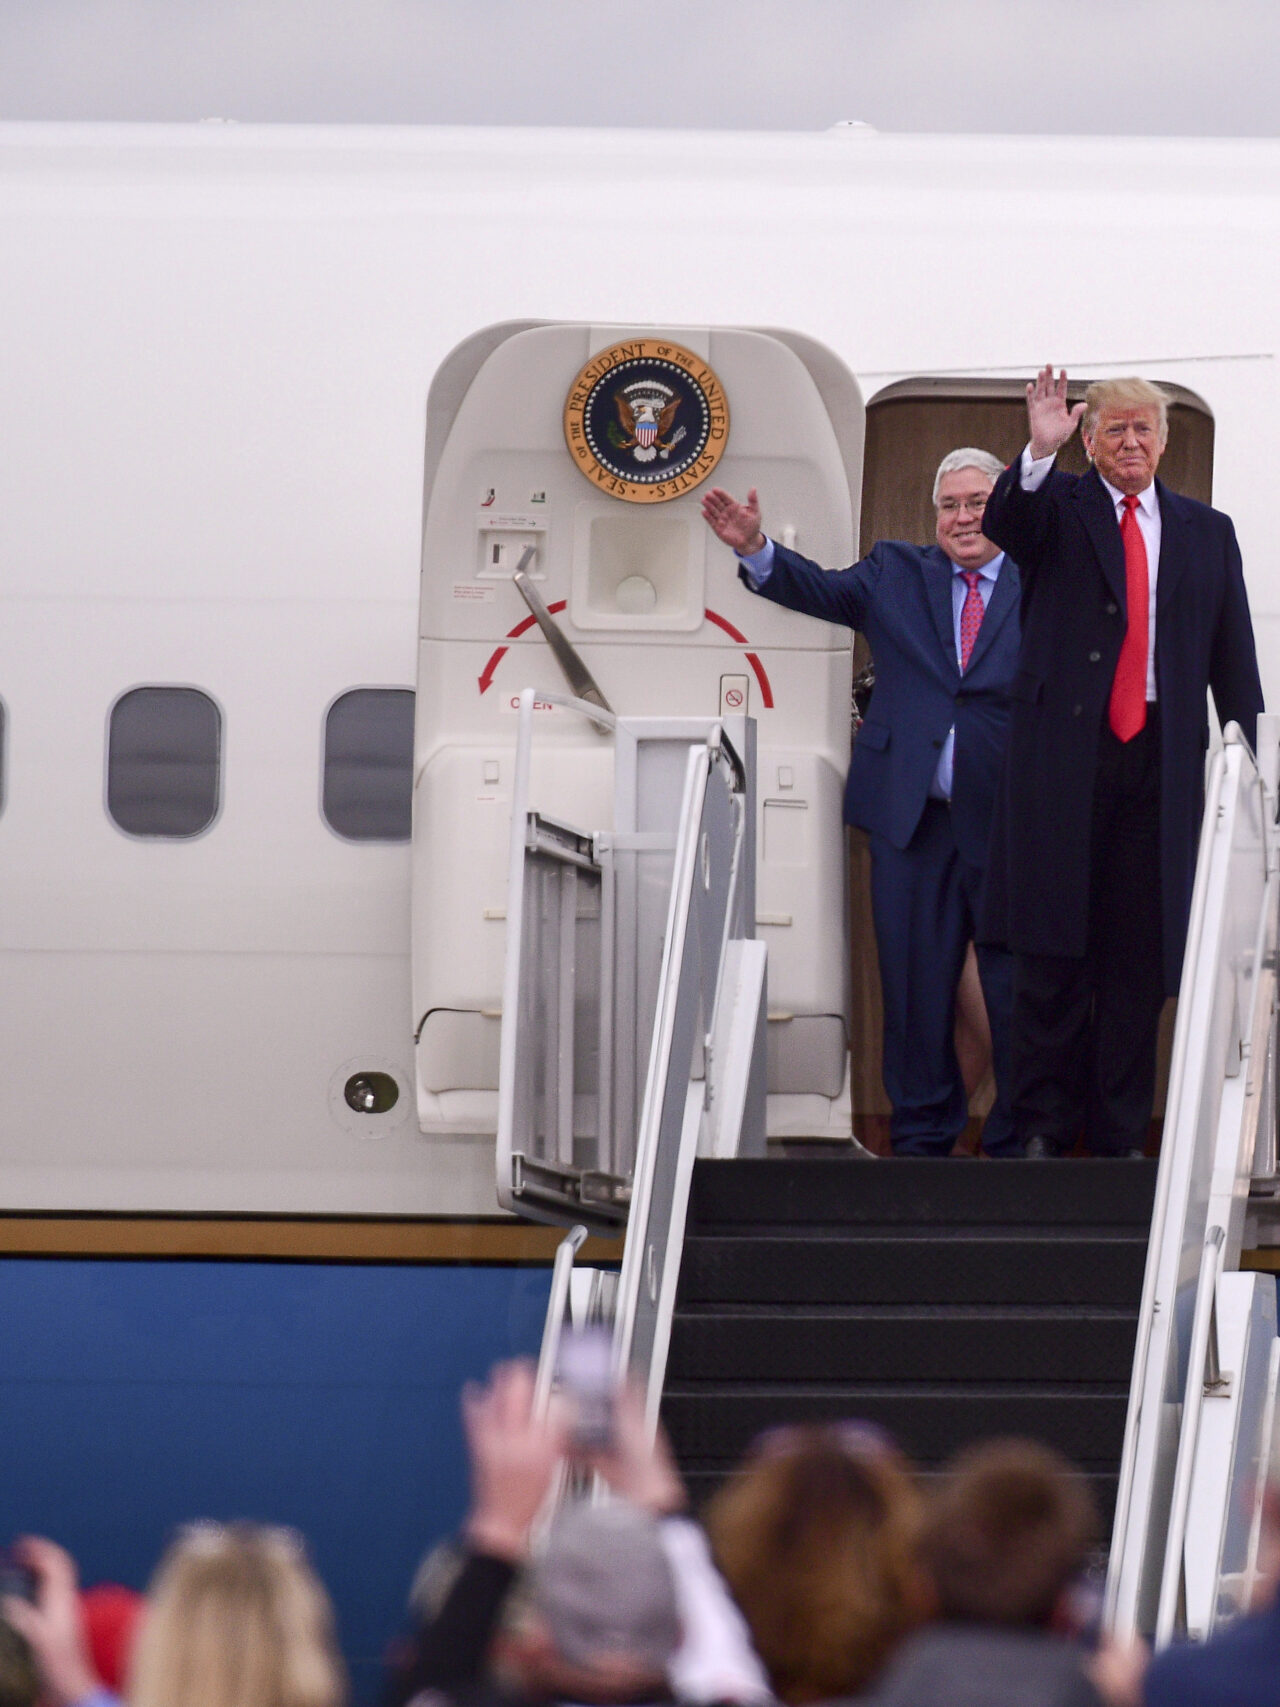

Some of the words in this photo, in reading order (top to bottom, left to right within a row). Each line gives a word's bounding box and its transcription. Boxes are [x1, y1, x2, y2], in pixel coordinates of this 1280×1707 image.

[657, 346, 671, 357] OF
[675, 352, 696, 369] THE
[570, 343, 646, 412] PRESIDENT
[698, 370, 726, 440] UNITED
[570, 422, 582, 440] THE
[576, 446, 588, 458] OF
[588, 466, 628, 495] SEAL
[656, 451, 715, 497] STATES
[510, 696, 553, 710] OEN
